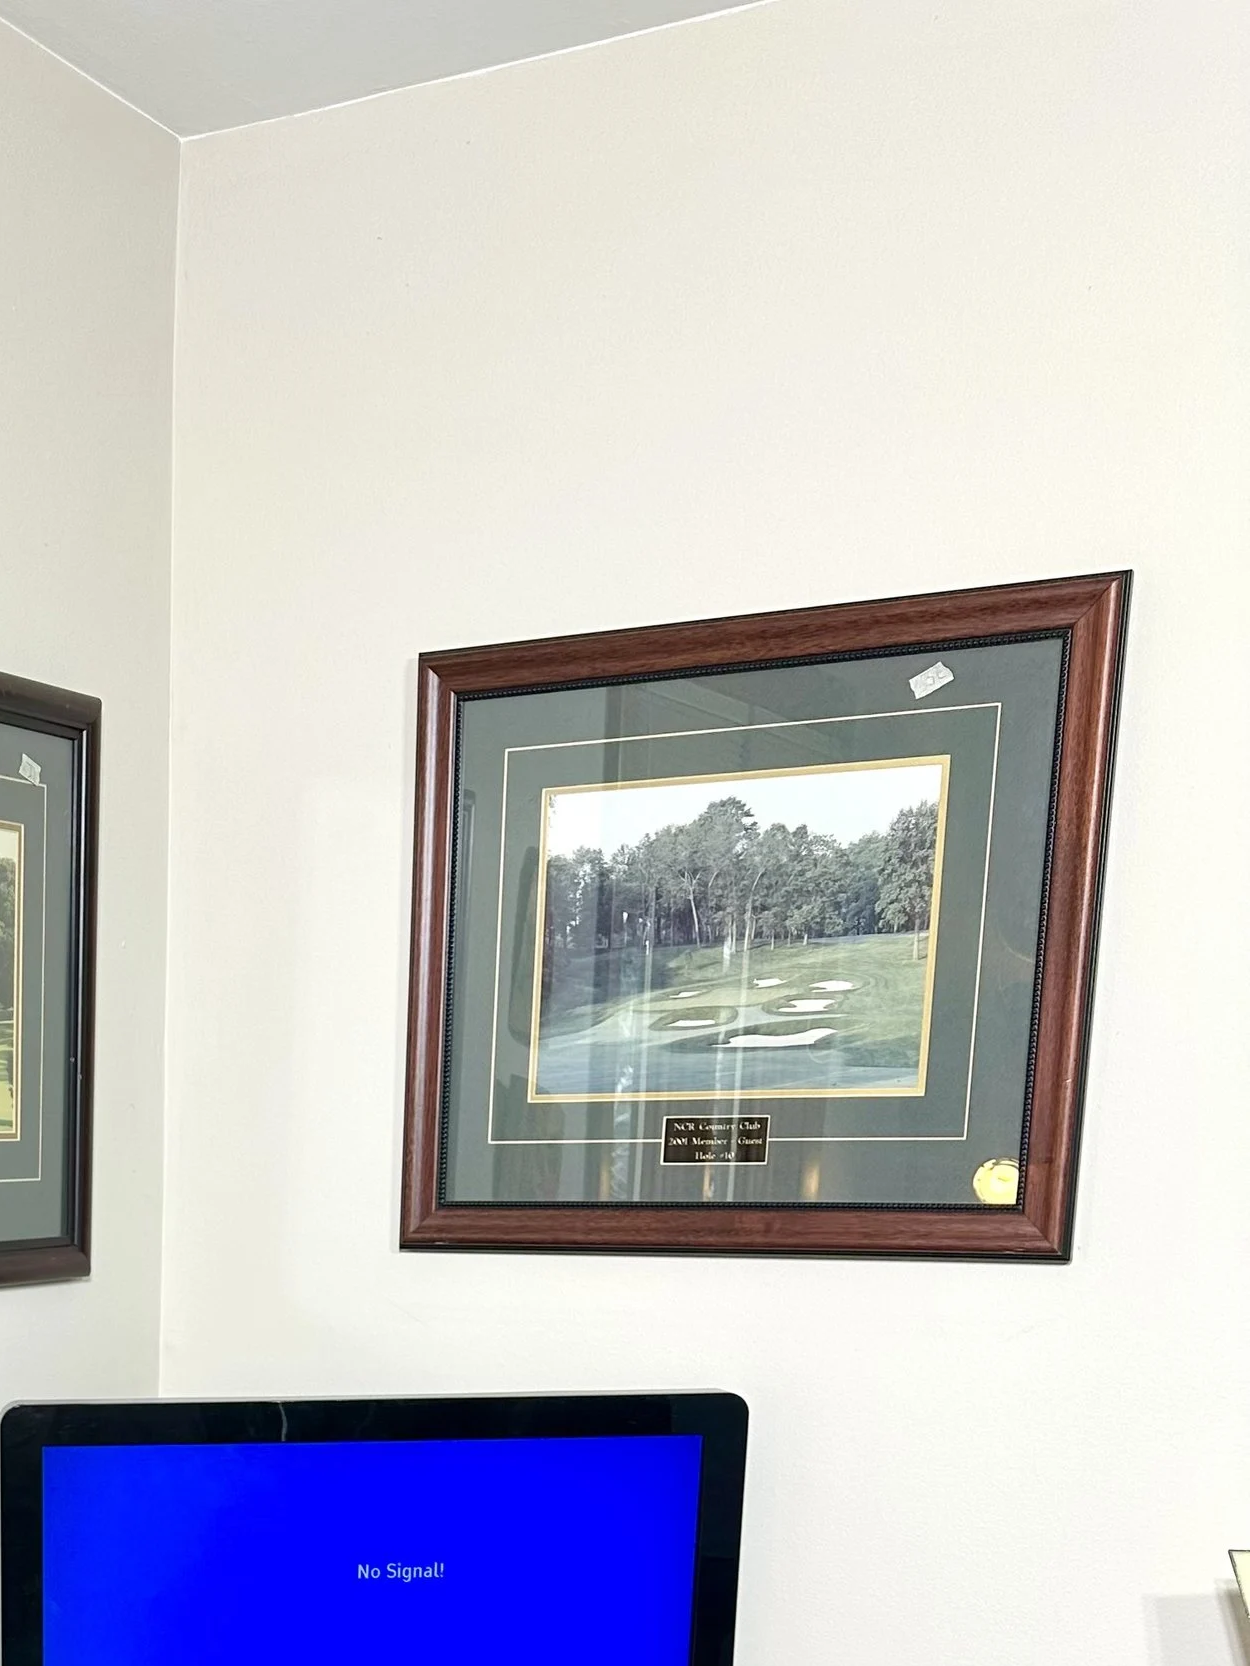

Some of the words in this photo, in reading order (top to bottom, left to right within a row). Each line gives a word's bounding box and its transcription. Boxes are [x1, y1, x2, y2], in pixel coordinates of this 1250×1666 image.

[673, 1122, 695, 1131] NCR
[699, 1122, 735, 1131] Country
[739, 1121, 761, 1130] Club
[692, 1136, 728, 1145] Member
[737, 1136, 763, 1145] Guest
[695, 1151, 717, 1160] Hole
[358, 1563, 381, 1579] No
[386, 1562, 444, 1582] Signal!
